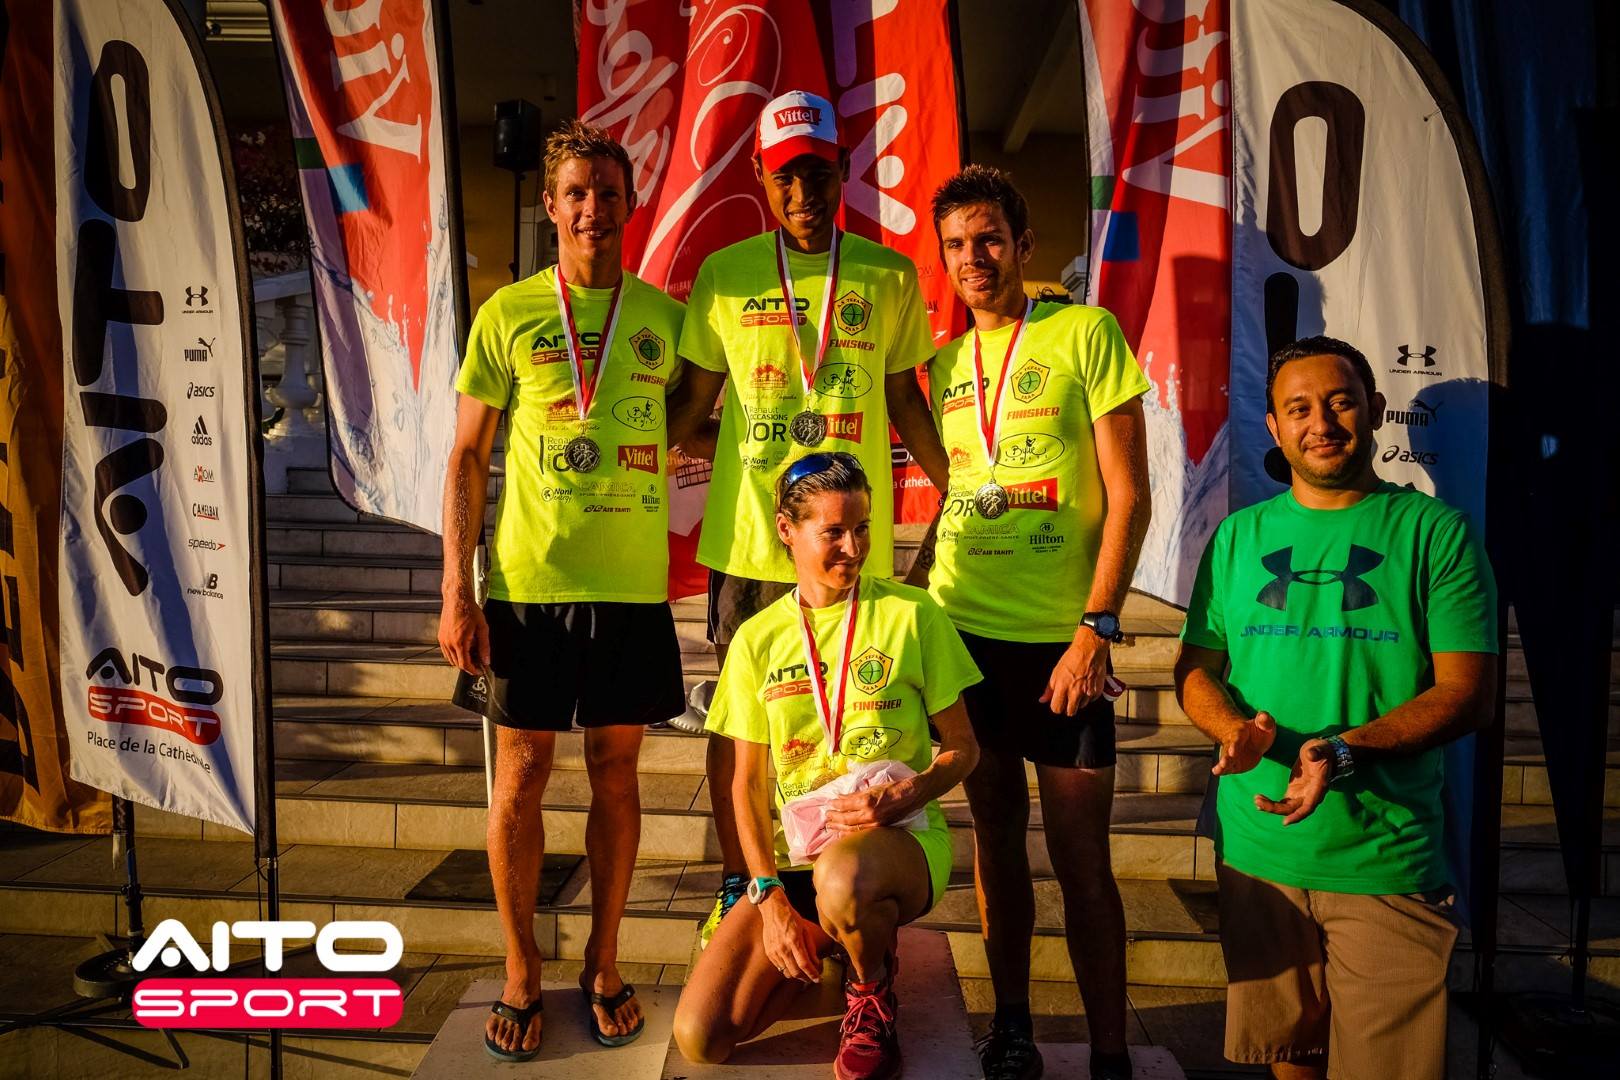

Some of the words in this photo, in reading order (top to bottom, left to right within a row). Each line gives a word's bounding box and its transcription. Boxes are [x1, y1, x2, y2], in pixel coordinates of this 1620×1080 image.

[778, 109, 815, 125] Vittel
[829, 339, 875, 352] FINISHER
[184, 349, 208, 362] PUMA
[630, 372, 666, 385] FINISHE
[1006, 406, 1060, 420] FINISHER
[1386, 410, 1429, 426] PUMA
[753, 422, 787, 442] OR
[191, 434, 213, 446] adidas
[624, 448, 654, 467] Vittel
[751, 457, 769, 465] Noni
[554, 487, 573, 495] Noni
[188, 538, 217, 551] speedo
[1029, 534, 1065, 545] Hilton
[187, 587, 202, 596] new
[1306, 626, 1400, 644] ARMOUR
[85, 647, 224, 706] AITO
[89, 692, 217, 737] SPORT
[87, 731, 116, 749] Place
[119, 737, 140, 752] de
[143, 739, 156, 754] la
